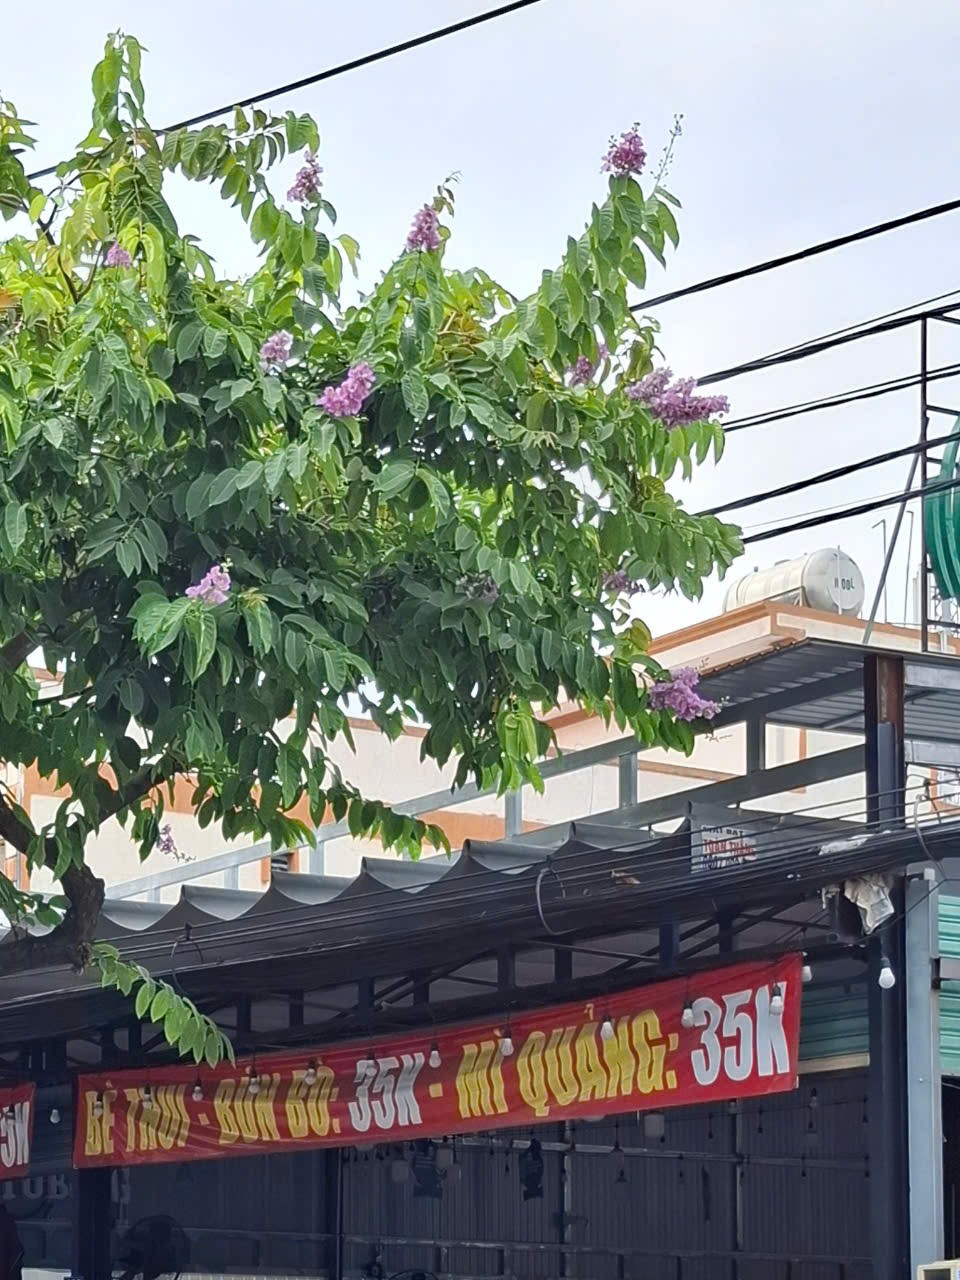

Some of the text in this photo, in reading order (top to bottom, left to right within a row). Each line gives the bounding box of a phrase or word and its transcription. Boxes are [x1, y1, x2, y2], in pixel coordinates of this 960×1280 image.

[124, 1083, 191, 1153] THUI
[214, 1065, 280, 1145] BÚN
[348, 1052, 425, 1132] 35K
[516, 1003, 680, 1117] QUẢNG:
[690, 980, 790, 1086] 35K
